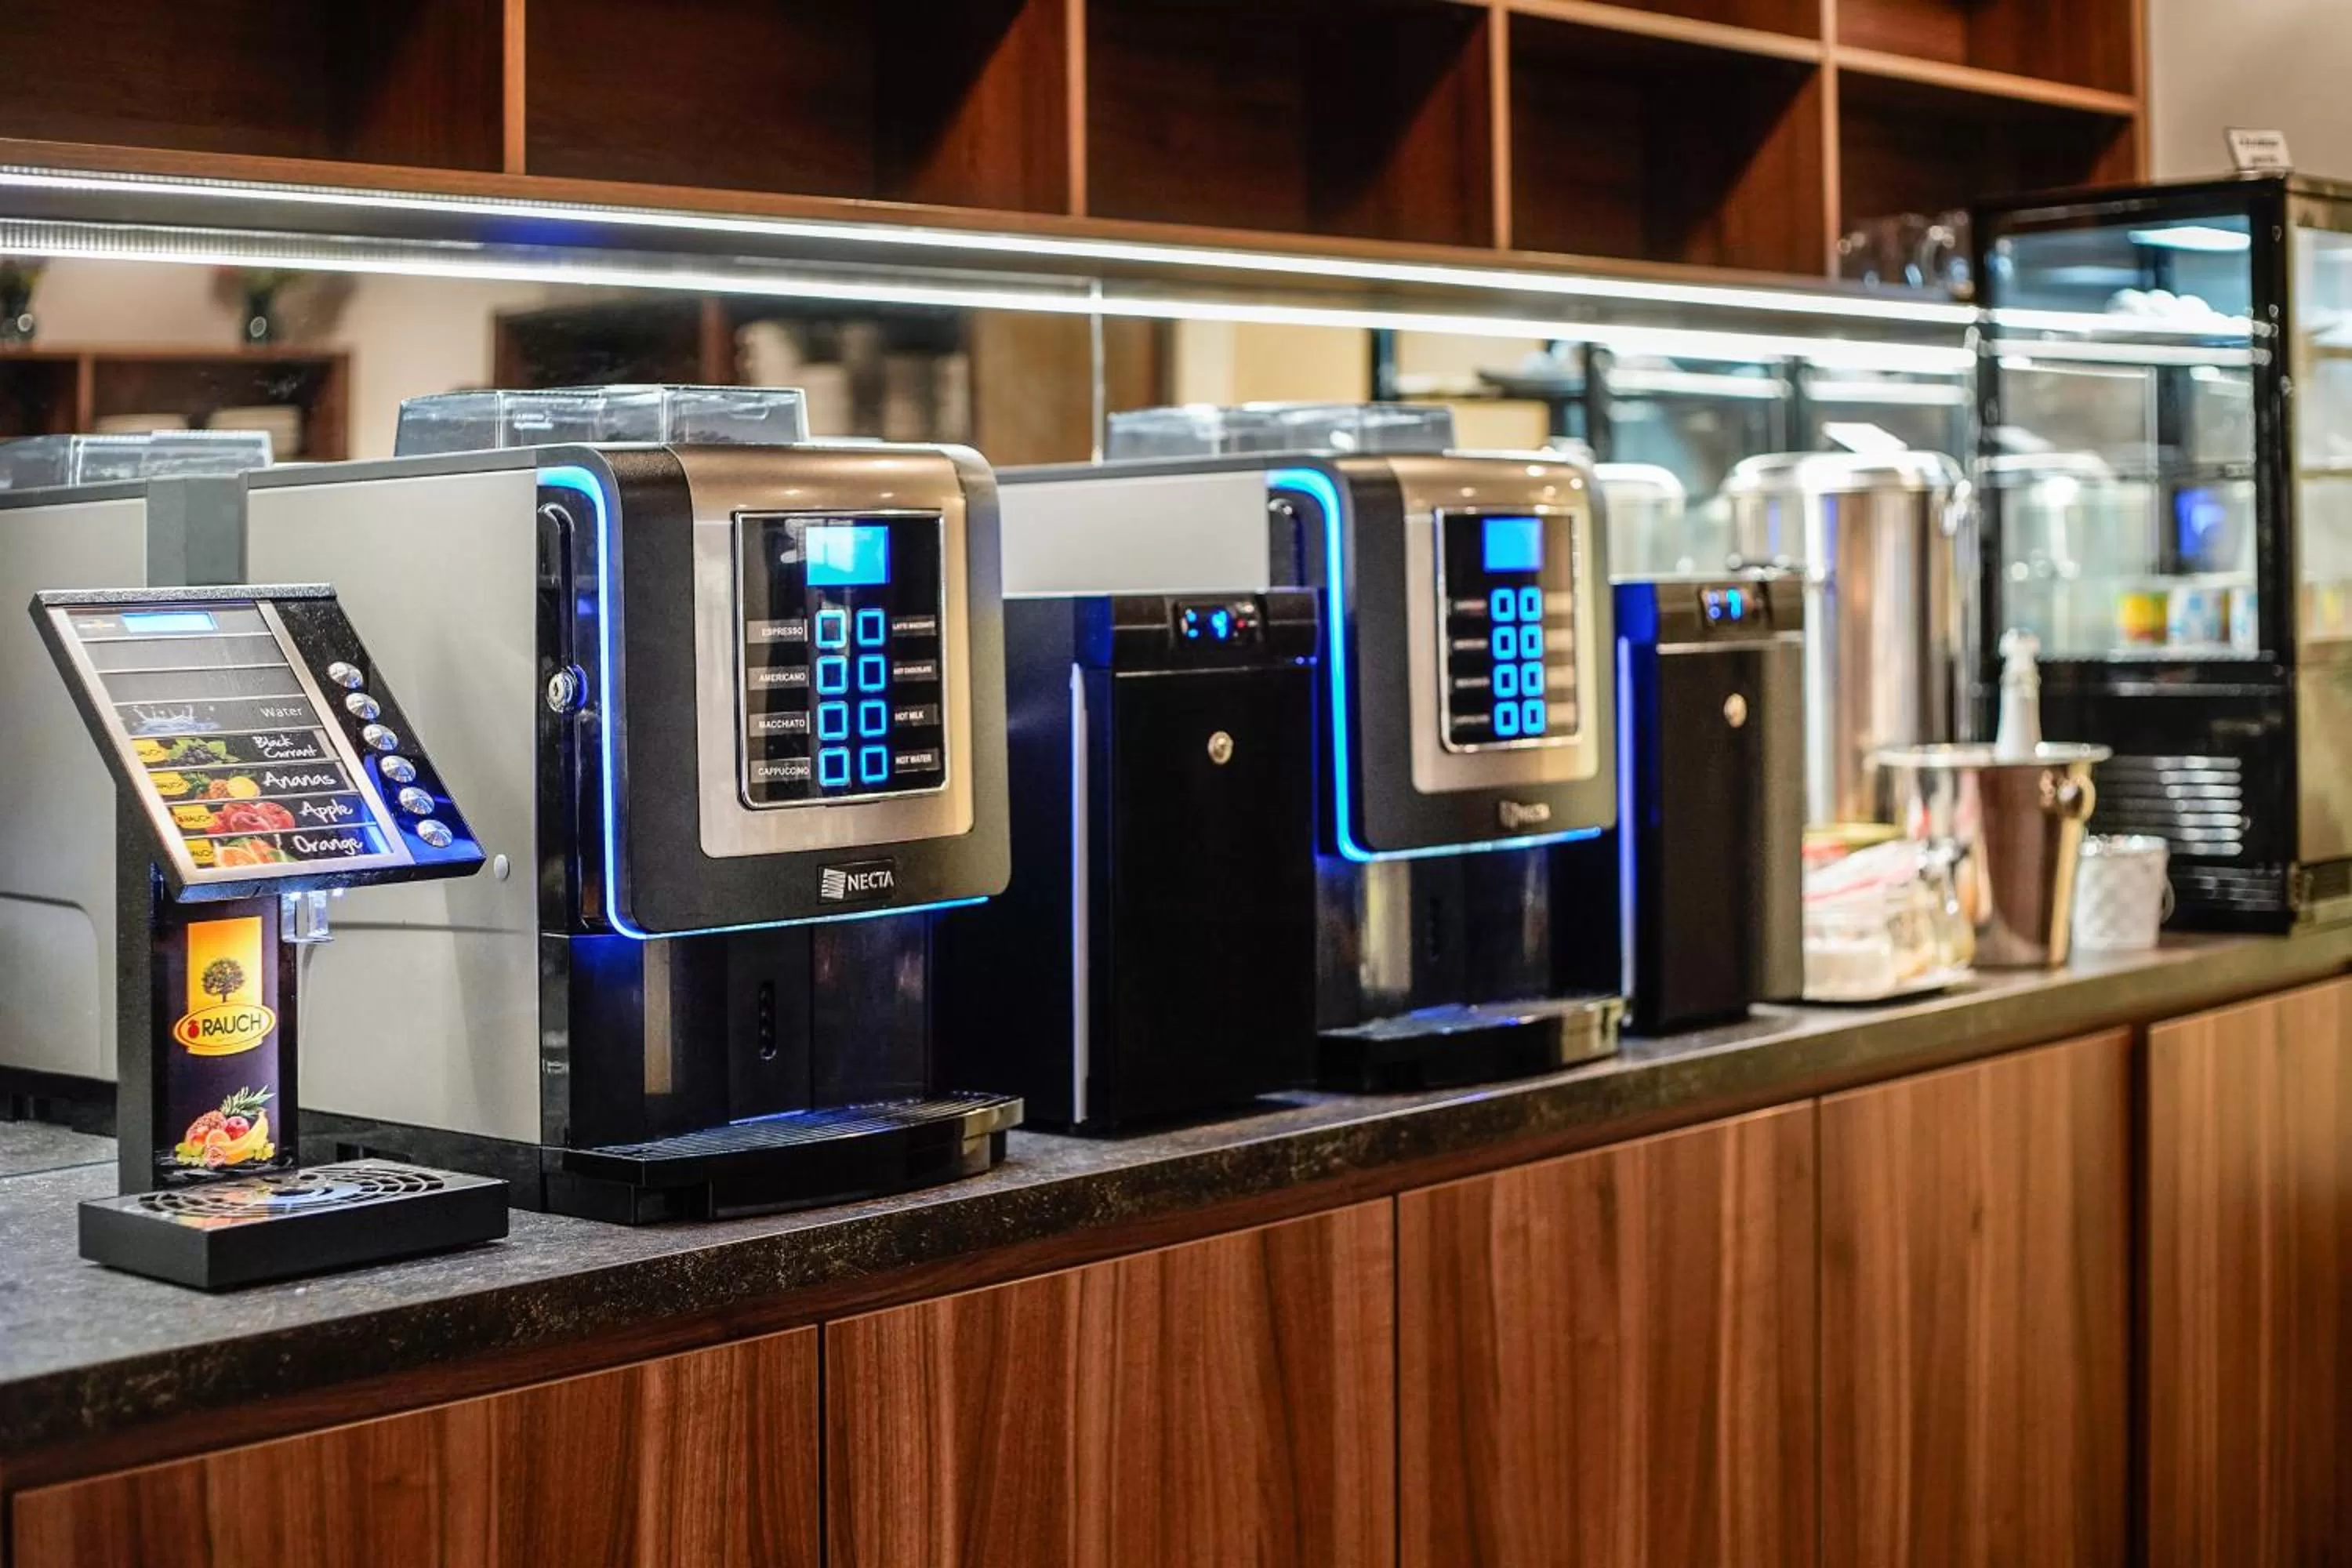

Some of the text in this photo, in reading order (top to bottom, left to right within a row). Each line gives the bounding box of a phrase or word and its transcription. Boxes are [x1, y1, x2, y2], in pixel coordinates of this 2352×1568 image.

[761, 626, 804, 637] ESPRESSO
[758, 672, 805, 683] AMERICANO
[260, 707, 303, 718] Water
[758, 720, 805, 730] MACCHIATO
[252, 734, 294, 749] Black
[263, 744, 318, 758] Currant
[758, 766, 810, 776] CAPPUCCINO
[263, 771, 337, 789] Ananas
[298, 798, 353, 823] Apple
[292, 835, 363, 855] Orange
[848, 870, 895, 891] NECTA
[201, 1013, 262, 1036] RAUCH
